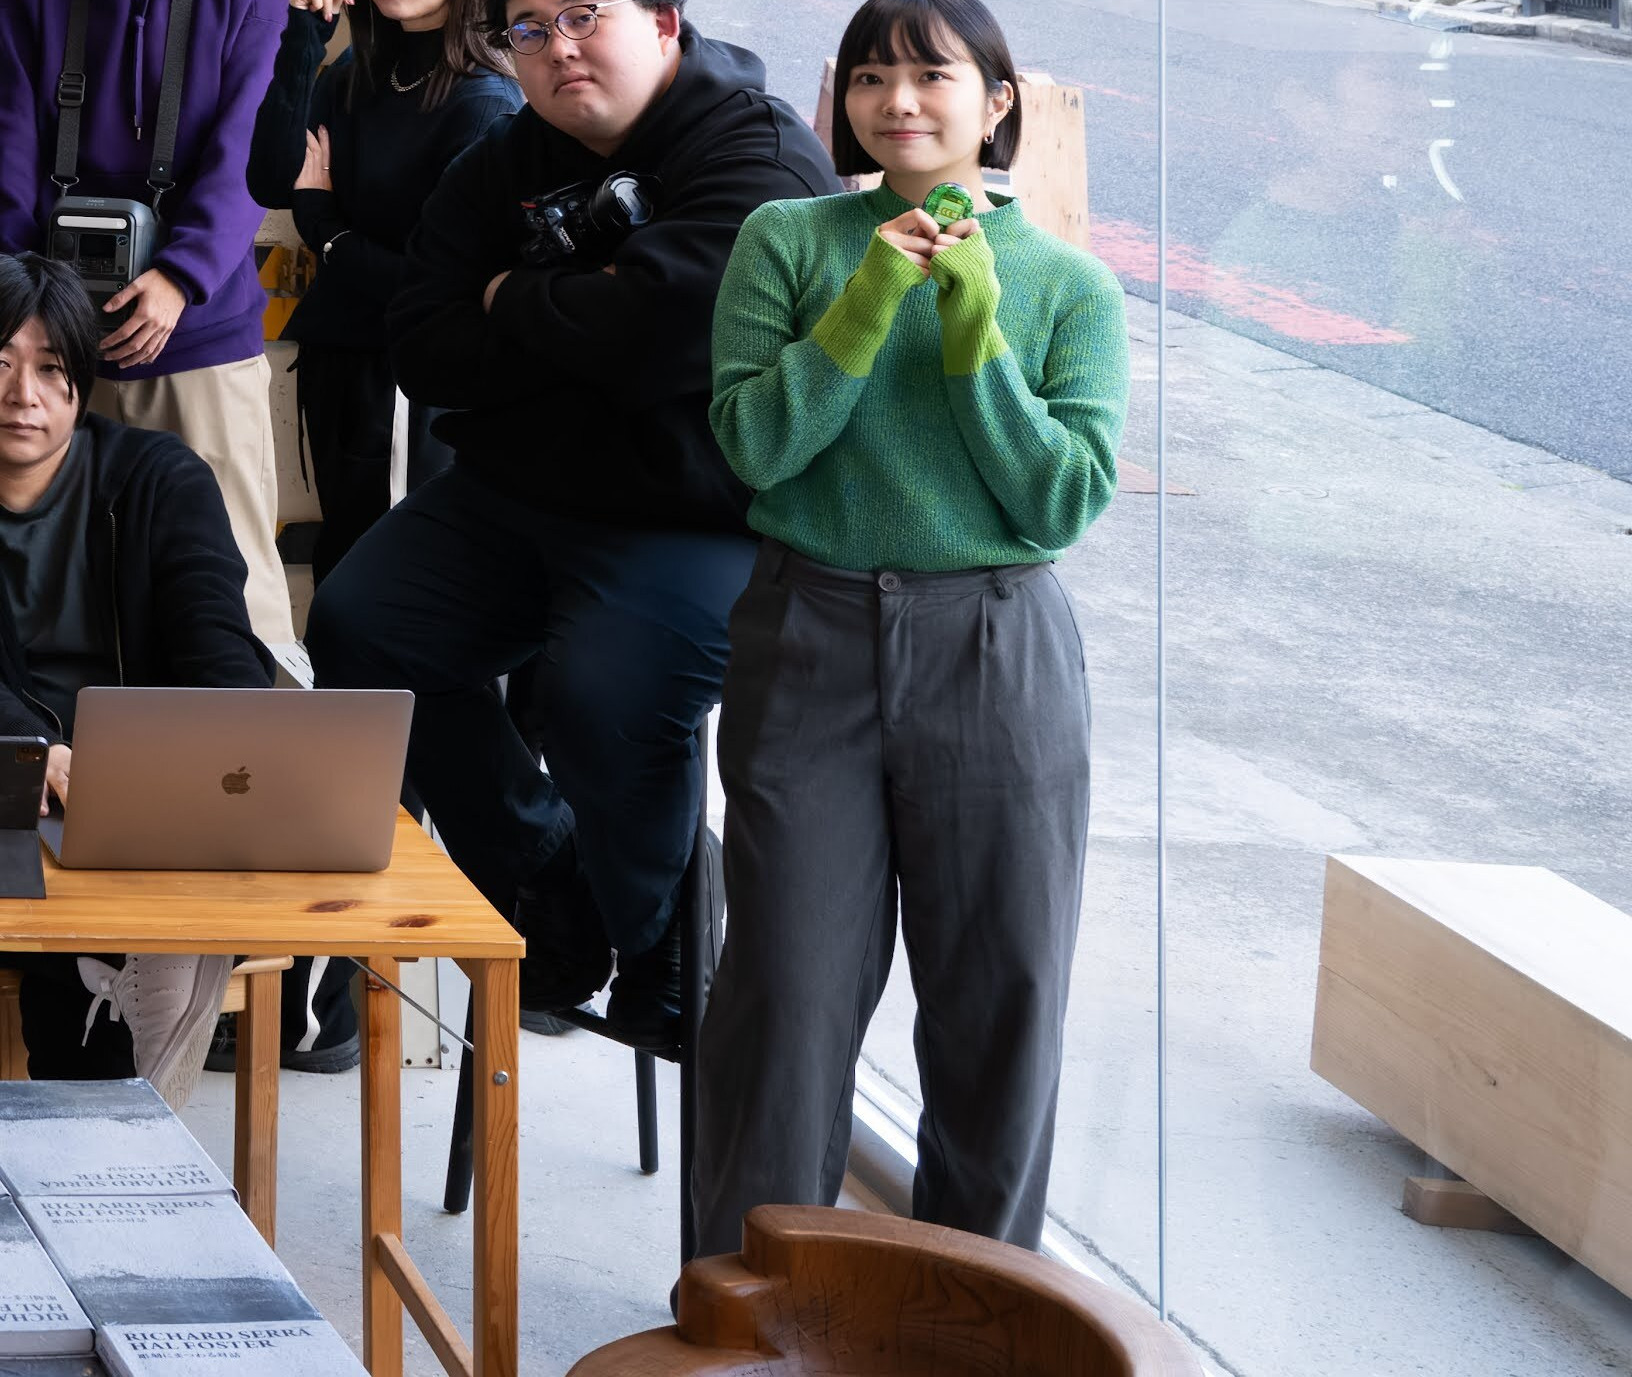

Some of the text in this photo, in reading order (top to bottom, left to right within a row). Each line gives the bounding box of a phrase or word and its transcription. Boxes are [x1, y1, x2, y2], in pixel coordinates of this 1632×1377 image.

[73, 1170, 206, 1181] HAL FOSTER
[37, 1177, 211, 1189] RICHARD SERRA
[39, 1200, 216, 1210] RICHARD SERRA
[45, 1208, 180, 1218] HAL FOSTER
[15, 1303, 64, 1312] HAL
[123, 1328, 314, 1342] RICHARD SERRA
[130, 1340, 279, 1352] HAL FOSTER
